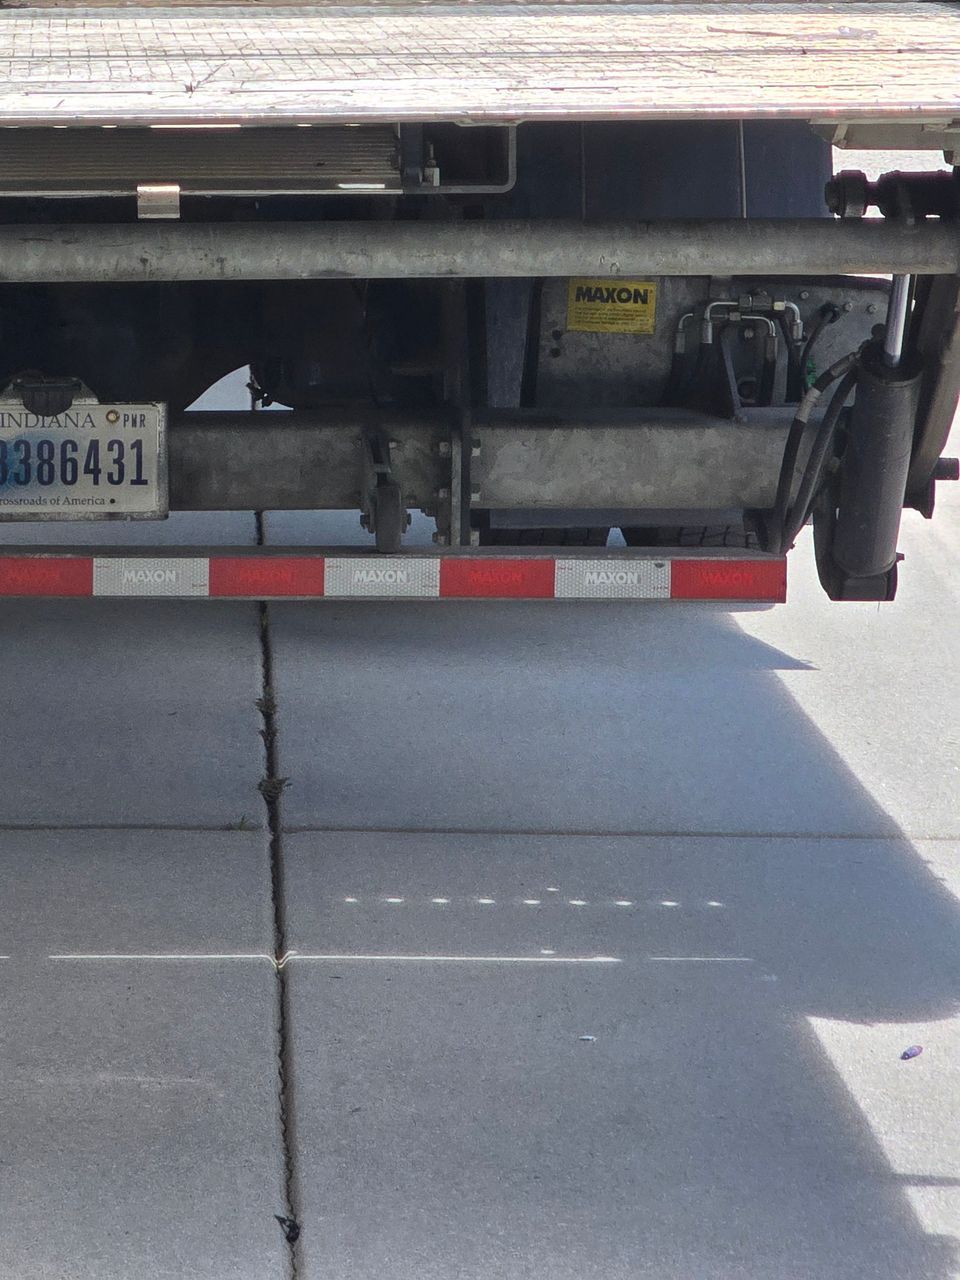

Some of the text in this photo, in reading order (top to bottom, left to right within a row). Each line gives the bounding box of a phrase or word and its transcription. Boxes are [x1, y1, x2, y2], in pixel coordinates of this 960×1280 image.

[575, 286, 648, 304] MAXON
[0, 412, 96, 428] INDIANA
[123, 413, 146, 428] PWR
[50, 496, 61, 506] of
[62, 496, 106, 506] America
[123, 569, 176, 582] MAXON
[354, 570, 407, 584] MAXON
[585, 571, 638, 584] MAXON
